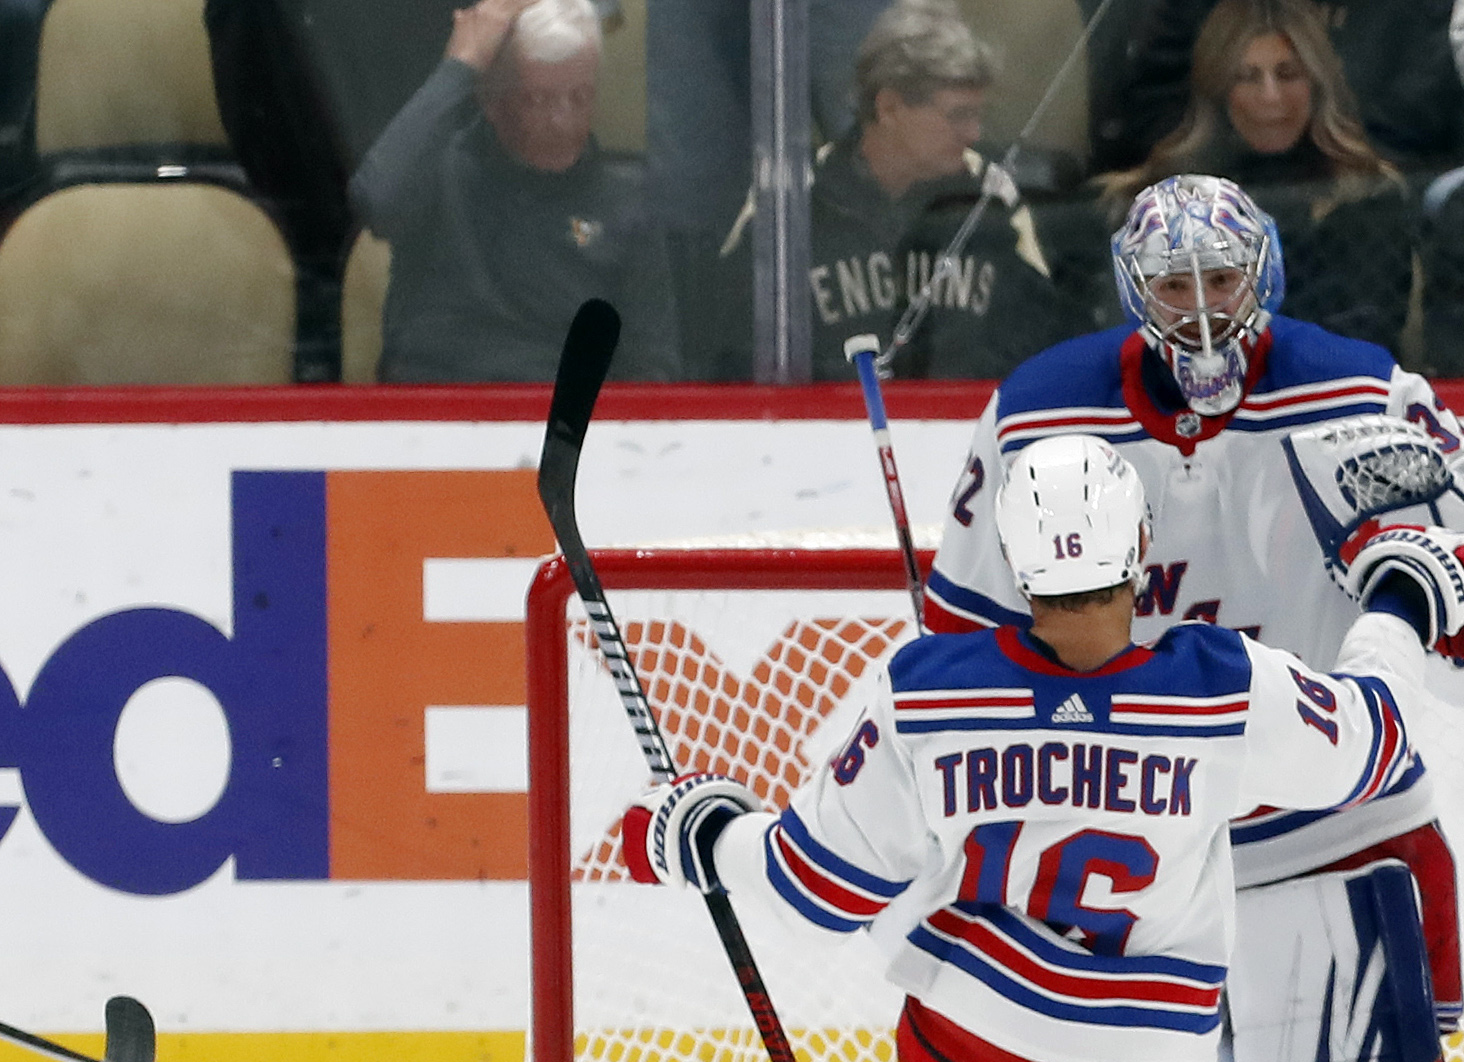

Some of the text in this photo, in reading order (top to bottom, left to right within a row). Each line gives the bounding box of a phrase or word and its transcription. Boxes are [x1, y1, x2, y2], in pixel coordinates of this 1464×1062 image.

[1052, 532, 1084, 560] 16
[1289, 664, 1338, 747] 16
[934, 742, 1199, 818] TROCHECK
[957, 820, 1160, 958] 16
